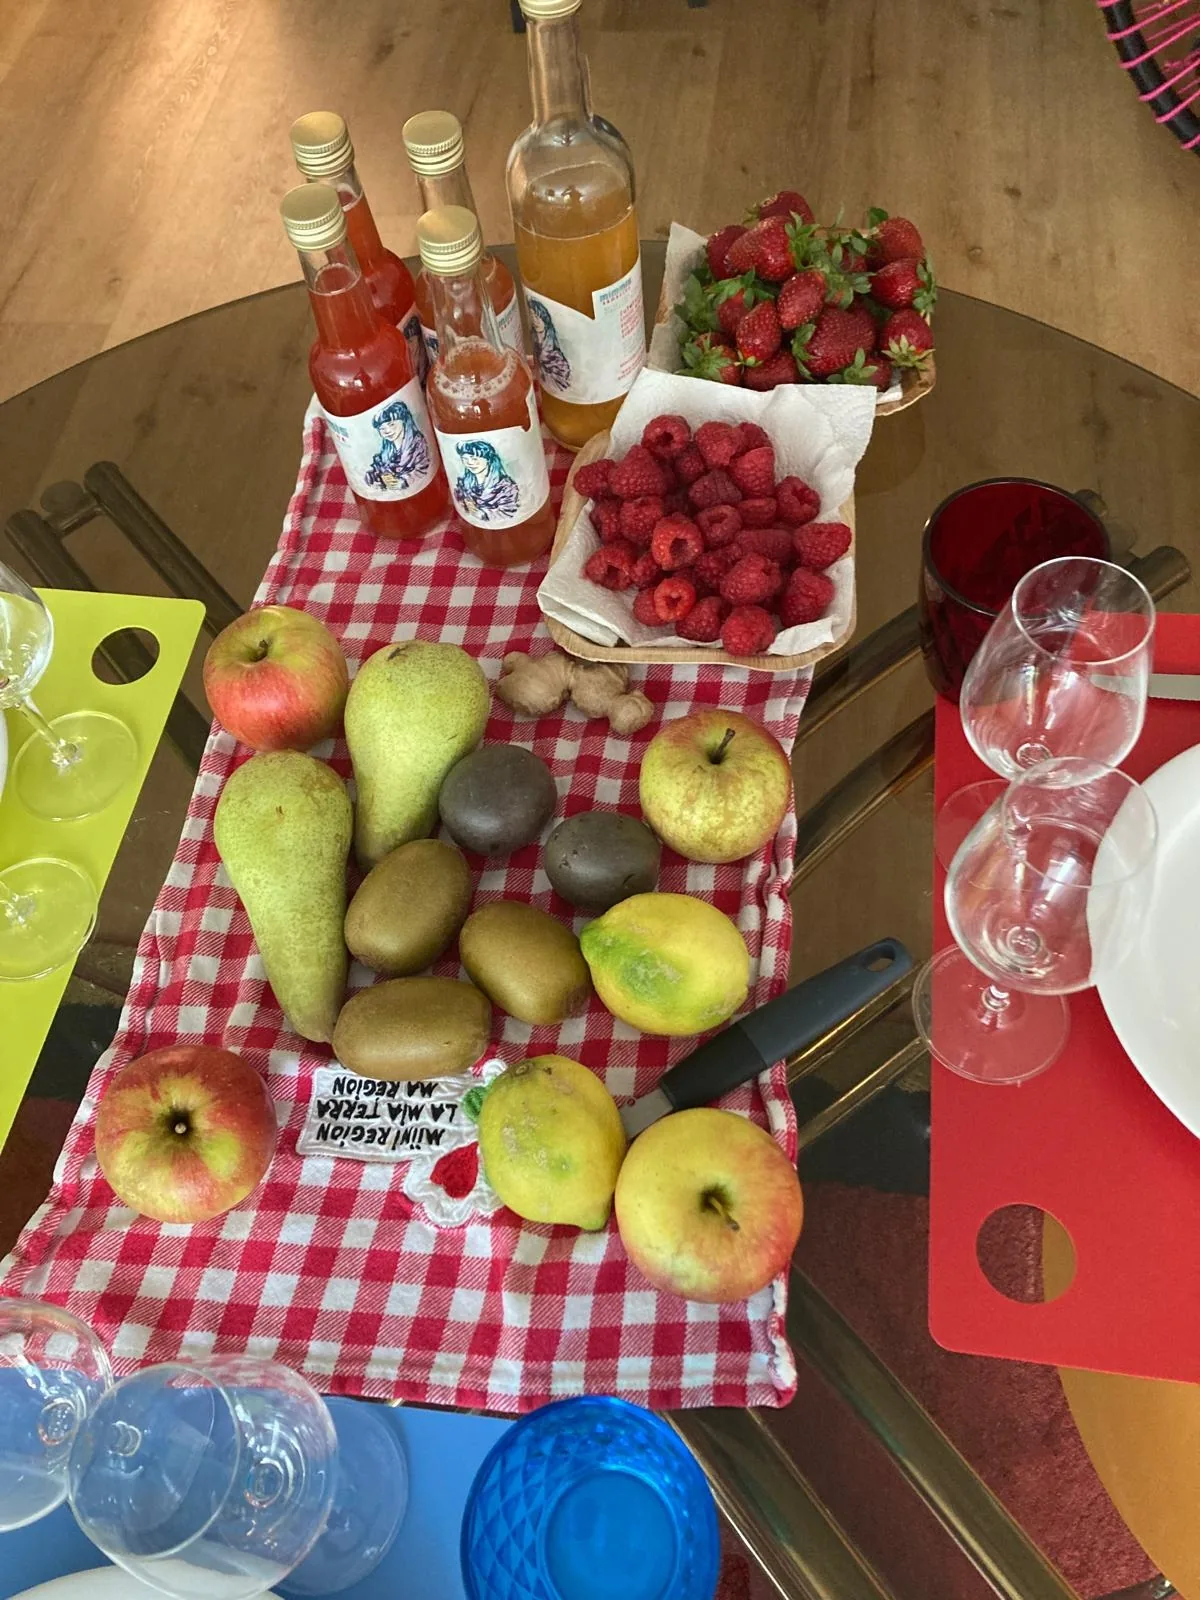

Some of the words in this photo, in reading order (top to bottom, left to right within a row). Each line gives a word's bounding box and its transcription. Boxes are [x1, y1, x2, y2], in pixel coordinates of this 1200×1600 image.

[407, 1081, 439, 1098] MA
[316, 1099, 381, 1121] TERRA
[388, 1102, 425, 1127] MIA
[430, 1103, 458, 1123] LA
[315, 1122, 391, 1147] REGION
